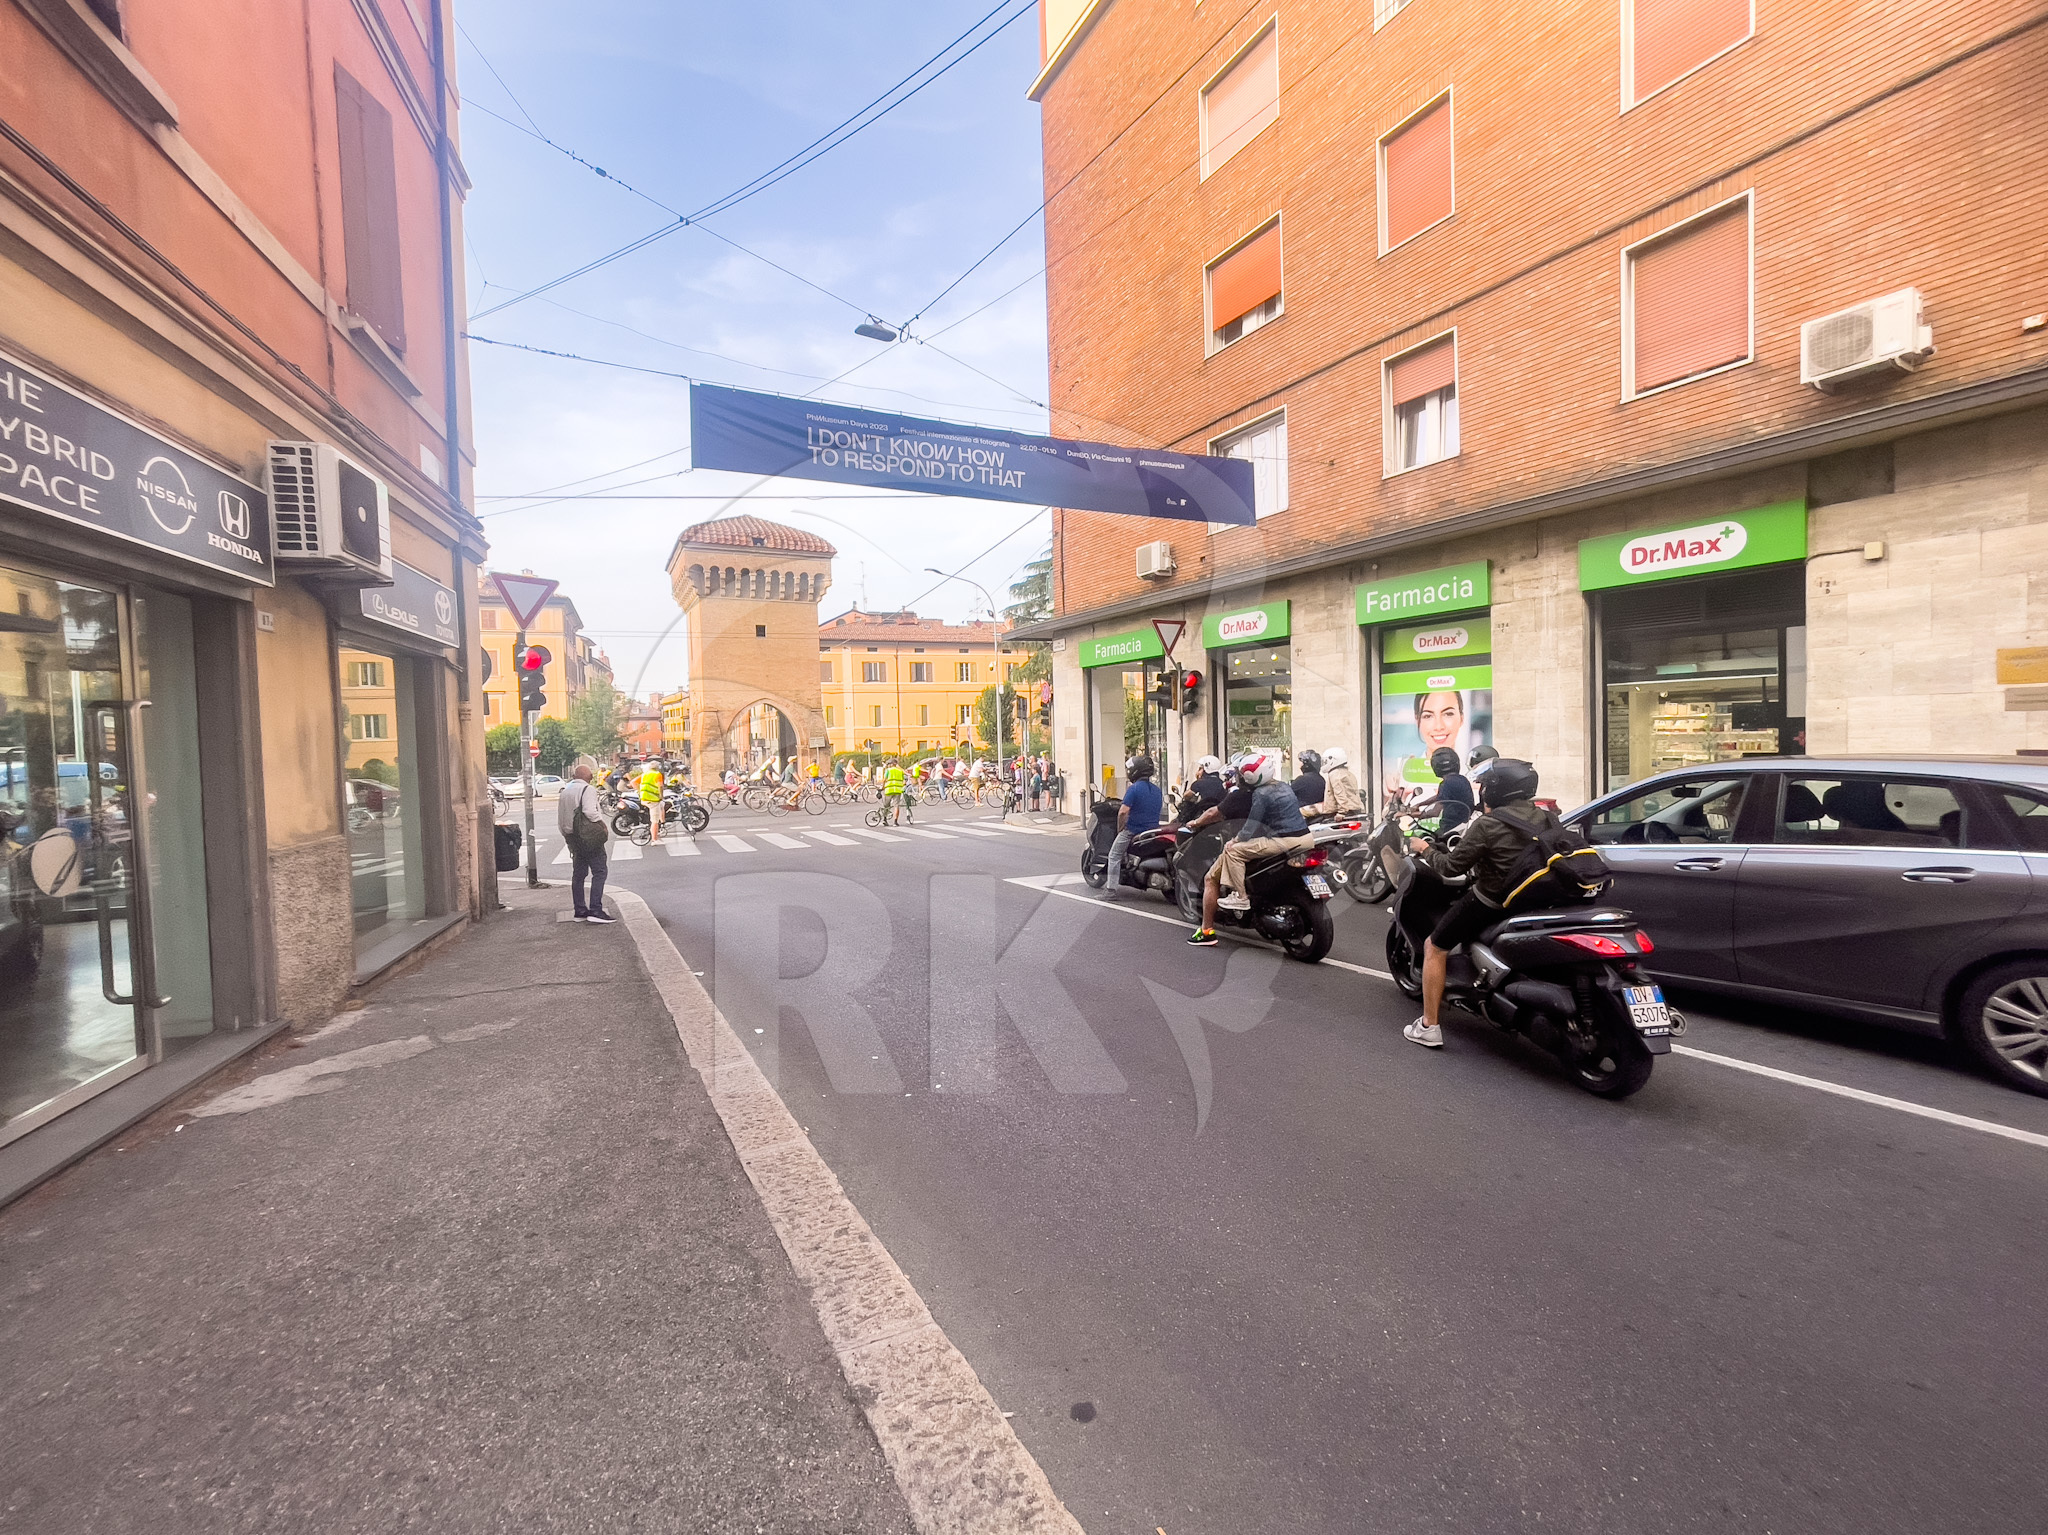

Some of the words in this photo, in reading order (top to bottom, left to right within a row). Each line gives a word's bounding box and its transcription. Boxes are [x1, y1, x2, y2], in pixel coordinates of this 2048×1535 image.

[806, 413, 849, 426] PhMuseum
[850, 419, 868, 429] Days
[869, 422, 888, 432] 2023
[0, 416, 115, 481] YBRID
[807, 426, 813, 445] I
[818, 428, 885, 453] DON'T
[889, 437, 954, 461] KNOW
[957, 446, 1005, 468] HOW
[900, 427, 926, 437] Festival
[926, 431, 972, 443] internazionale
[980, 439, 1010, 448] fotografia
[807, 445, 839, 467] TO
[844, 450, 945, 479] RESPOND
[947, 462, 974, 483] TO
[976, 466, 1026, 488] THAT
[136, 477, 198, 513] NISSAN
[207, 531, 264, 565] HONDA
[1366, 576, 1473, 614] Farmacia
[384, 603, 419, 628] LEXUS
[1094, 637, 1142, 659] Farmacia
[1632, 988, 1648, 1003] DV
[1633, 1006, 1668, 1024] 53076
